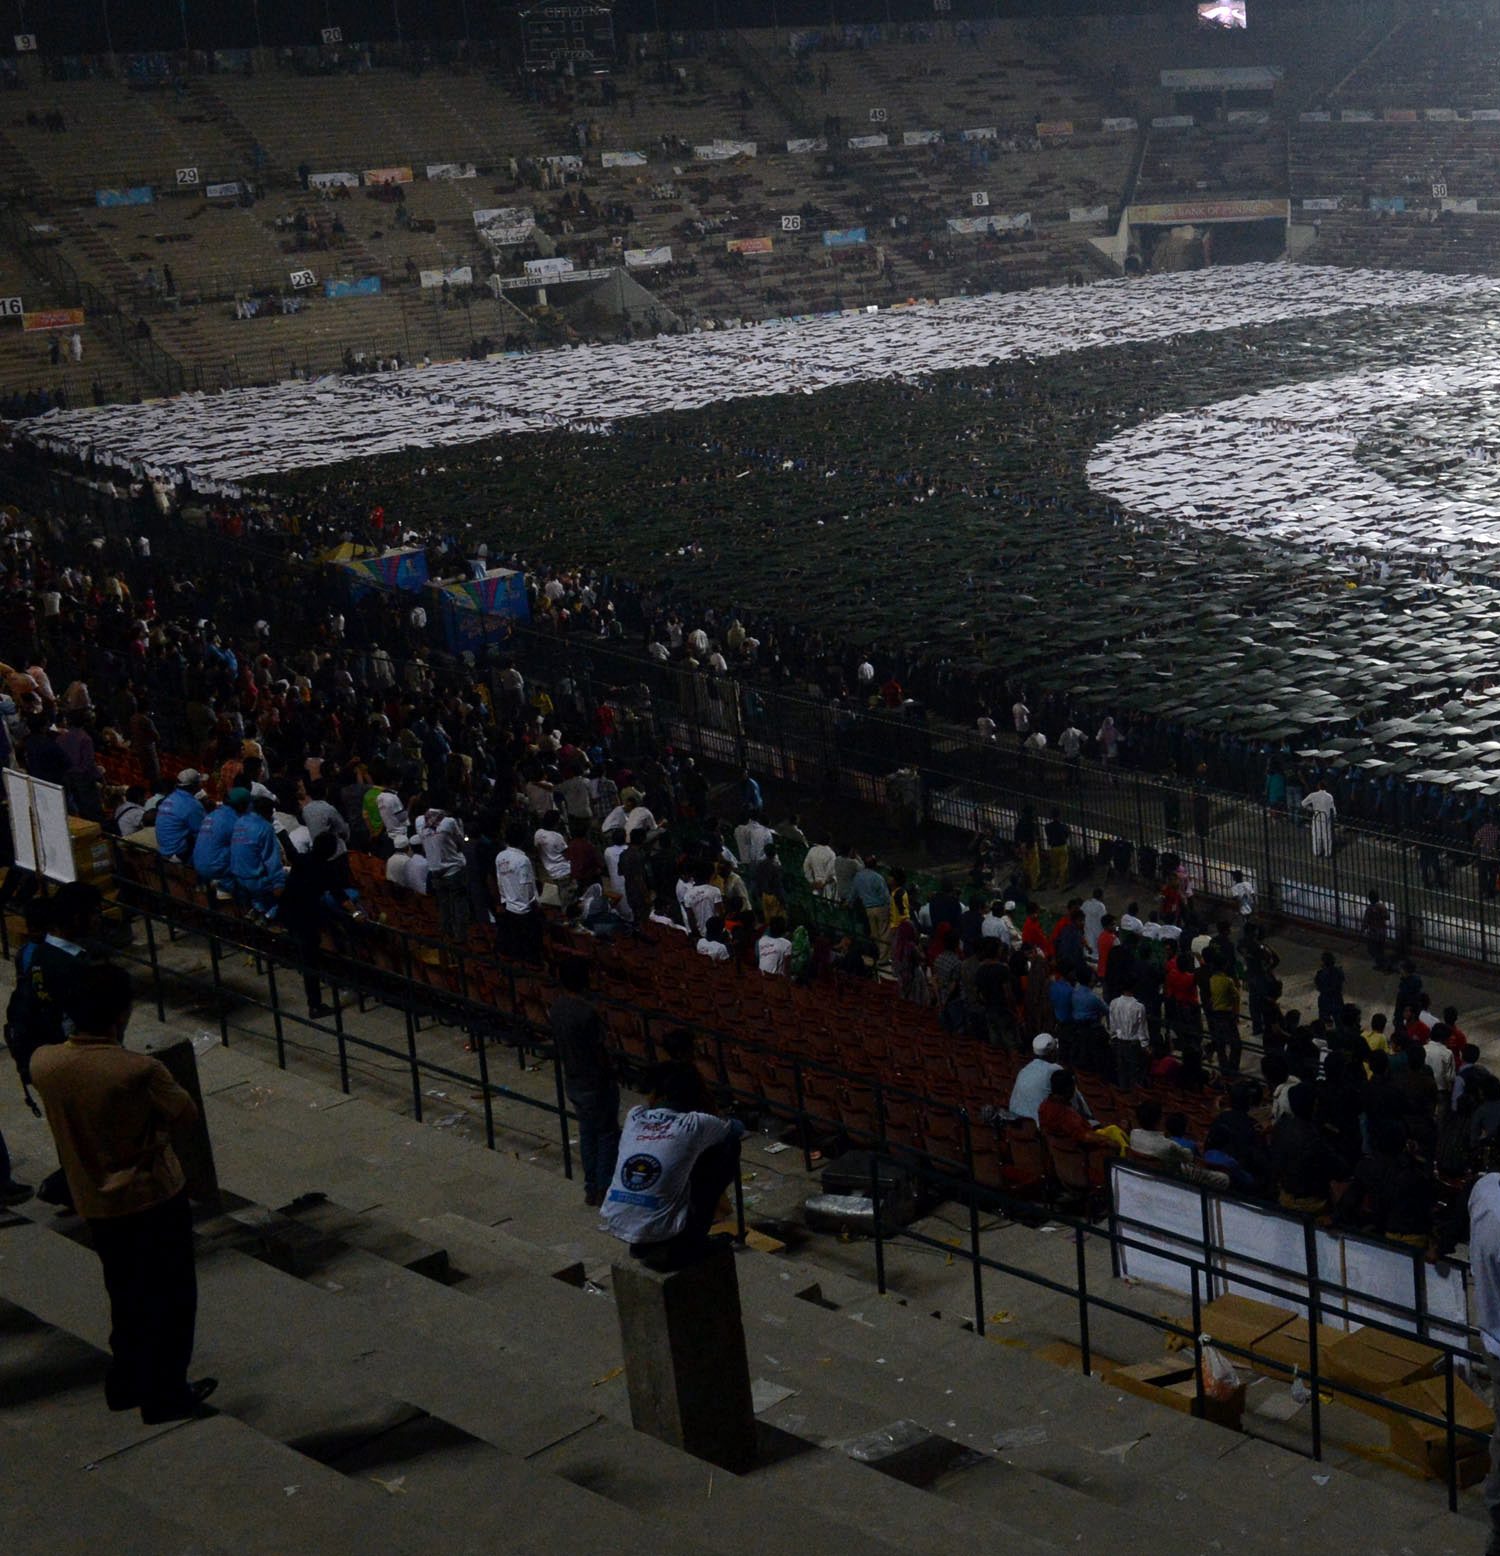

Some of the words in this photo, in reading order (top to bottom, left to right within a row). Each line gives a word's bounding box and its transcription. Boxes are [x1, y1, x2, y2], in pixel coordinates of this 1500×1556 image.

[324, 29, 340, 41] 20
[871, 110, 884, 120] 49
[178, 170, 197, 182] 29
[1434, 185, 1446, 197] 30
[784, 217, 800, 229] 26
[293, 272, 313, 287] 28
[0, 299, 21, 314] 16
